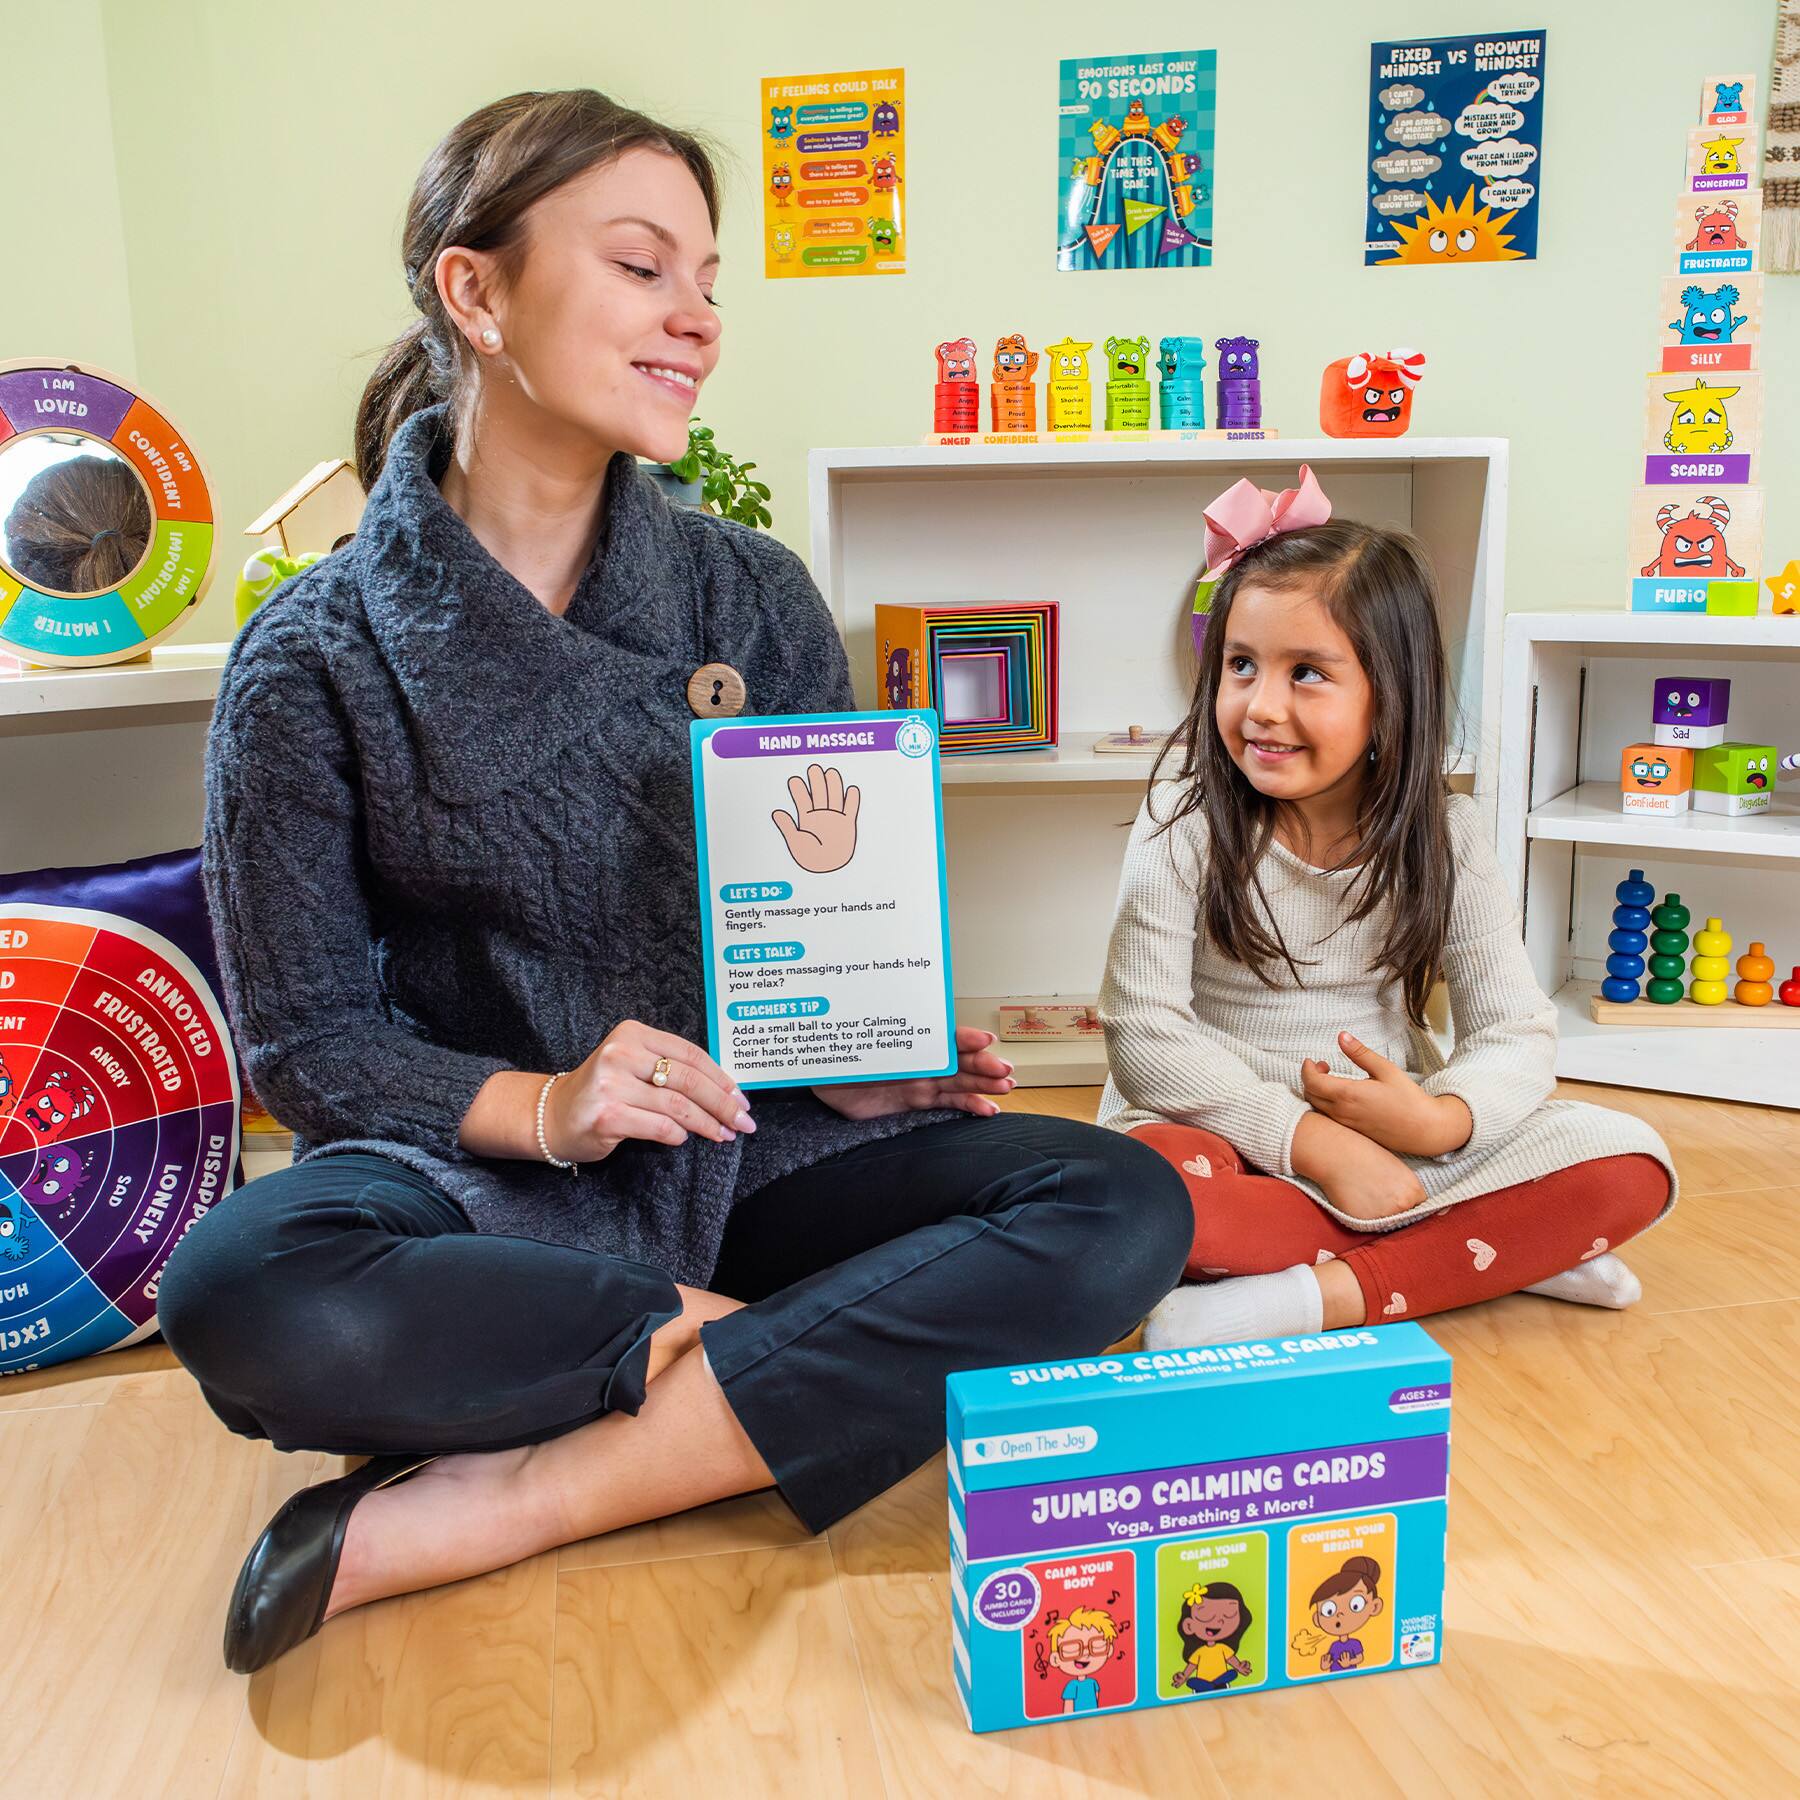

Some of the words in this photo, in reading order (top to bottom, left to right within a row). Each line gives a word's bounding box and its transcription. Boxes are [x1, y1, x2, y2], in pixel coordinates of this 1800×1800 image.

[1474, 40, 1540, 57] GROWTH
[1447, 50, 1467, 64] VS
[1139, 63, 1164, 75] LAST
[1167, 61, 1197, 72] ONLY
[769, 88, 779, 98] IF
[782, 84, 830, 97] FEELINGS
[833, 81, 868, 93] COULD
[872, 79, 897, 90] TALK
[1078, 80, 1102, 99] 90
[1108, 74, 1196, 99] SECONDS
[1500, 112, 1516, 120] HELP
[1477, 127, 1502, 135] GROW!
[1117, 157, 1128, 167] IN
[1467, 153, 1488, 161] WHAT
[1490, 152, 1505, 160] CAN
[1512, 151, 1534, 159] LEARN
[1477, 160, 1498, 168] FROM
[1137, 167, 1159, 177] YOU
[1694, 179, 1746, 189] CONCERNED
[1683, 257, 1748, 269] FRUSTRATED
[43, 378, 48, 389] I
[53, 379, 75, 391] AM
[34, 399, 88, 417] LOVED
[940, 437, 971, 445] ANGER
[984, 435, 1039, 444] CONFIDENCE
[1180, 432, 1198, 441] JOY
[1227, 431, 1265, 441] SADNESS
[169, 442, 179, 450] I
[174, 451, 192, 472] AM
[129, 430, 181, 509] CONFIDENT
[1670, 463, 1725, 477] SCARED
[135, 532, 183, 609] IMPORTANT
[174, 574, 191, 595] AM
[1654, 588, 1707, 604] FURiO
[34, 615, 99, 637] MATTER
[103, 619, 112, 633] I
[759, 735, 802, 750] HAND
[806, 732, 875, 749] MASSAGE
[913, 733, 917, 743] 1
[1672, 727, 1690, 739] Sad
[1625, 795, 1670, 809] Confident
[1739, 795, 1768, 810] Disgusted
[730, 887, 758, 899] LET'S
[762, 886, 783, 898] DO:
[725, 908, 761, 920] Gently
[764, 907, 811, 918] massage
[814, 905, 838, 917] your
[841, 901, 873, 912] hands
[876, 900, 896, 910] and
[726, 920, 766, 932] fingers.
[733, 948, 760, 960] LET'S
[764, 946, 796, 959] TALK:
[729, 969, 754, 978] How
[757, 967, 783, 977] does
[786, 963, 843, 976] massaging
[846, 963, 870, 974] your
[872, 959, 904, 970] hands
[907, 957, 931, 969] help
[729, 982, 749, 993] you
[752, 977, 785, 989] relax?
[136, 968, 213, 1057] ANNOYED
[736, 1002, 797, 1017] TEACHER'S
[732, 1024, 755, 1035] Add
[758, 1026, 765, 1034] a
[768, 1022, 795, 1033] small
[798, 1021, 818, 1031] ball
[821, 1022, 833, 1030] to
[836, 1021, 860, 1031] your
[863, 1016, 907, 1027] Calming
[93, 991, 182, 1092] FRUSTRATED
[733, 1037, 770, 1047] Corner
[773, 1034, 789, 1044] for
[792, 1032, 839, 1043] students
[842, 1032, 853, 1040] to
[856, 1028, 874, 1039] roll
[877, 1026, 914, 1038] around
[733, 1048, 759, 1058] their
[762, 1045, 794, 1056] hands
[796, 1044, 826, 1054] when
[829, 1042, 853, 1053] they
[856, 1042, 873, 1050] are
[876, 1039, 913, 1050] feeling
[90, 1046, 131, 1089] ANGRY
[734, 1059, 784, 1070] moments
[787, 1056, 798, 1066] of
[802, 1054, 862, 1066] uneasiness.
[108, 1175, 132, 1207] SAD
[133, 1163, 183, 1245] LONELY
[1009, 1360, 1124, 1386] JUMBO
[1281, 1331, 1379, 1353] CARDS
[1113, 1373, 1157, 1384] Yoga,
[1159, 1362, 1232, 1378] Breathing
[1235, 1359, 1248, 1369] &
[1250, 1356, 1296, 1367] More!
[1399, 1390, 1425, 1402] AGES
[1427, 1389, 1440, 1398] 2+
[1000, 1440, 1032, 1457] Open
[1035, 1436, 1058, 1452] The
[1063, 1433, 1086, 1450] Joy
[1031, 1484, 1142, 1524] JUMBO
[1152, 1465, 1283, 1506] CALMING
[1293, 1452, 1386, 1487] CARDS
[1106, 1520, 1155, 1538] Yoga,
[1160, 1505, 1241, 1530] Breathing
[1246, 1503, 1260, 1518] &
[1264, 1495, 1315, 1515] More!
[1300, 1528, 1351, 1544] CONTROL
[1354, 1523, 1386, 1536] YOUR
[1180, 1547, 1212, 1561] CALM
[1216, 1543, 1247, 1556] YOUR
[1322, 1539, 1364, 1553] BREATH
[1045, 1565, 1077, 1580] CALM
[1080, 1560, 1114, 1575] YOUR
[994, 1580, 1021, 1600] 30
[1063, 1576, 1096, 1590] BODY
[984, 1602, 1008, 1611] JUMBO
[1009, 1598, 1032, 1607] CARDS
[991, 1609, 1026, 1619] INCLUDED
[1401, 1622, 1435, 1634] OWNED
